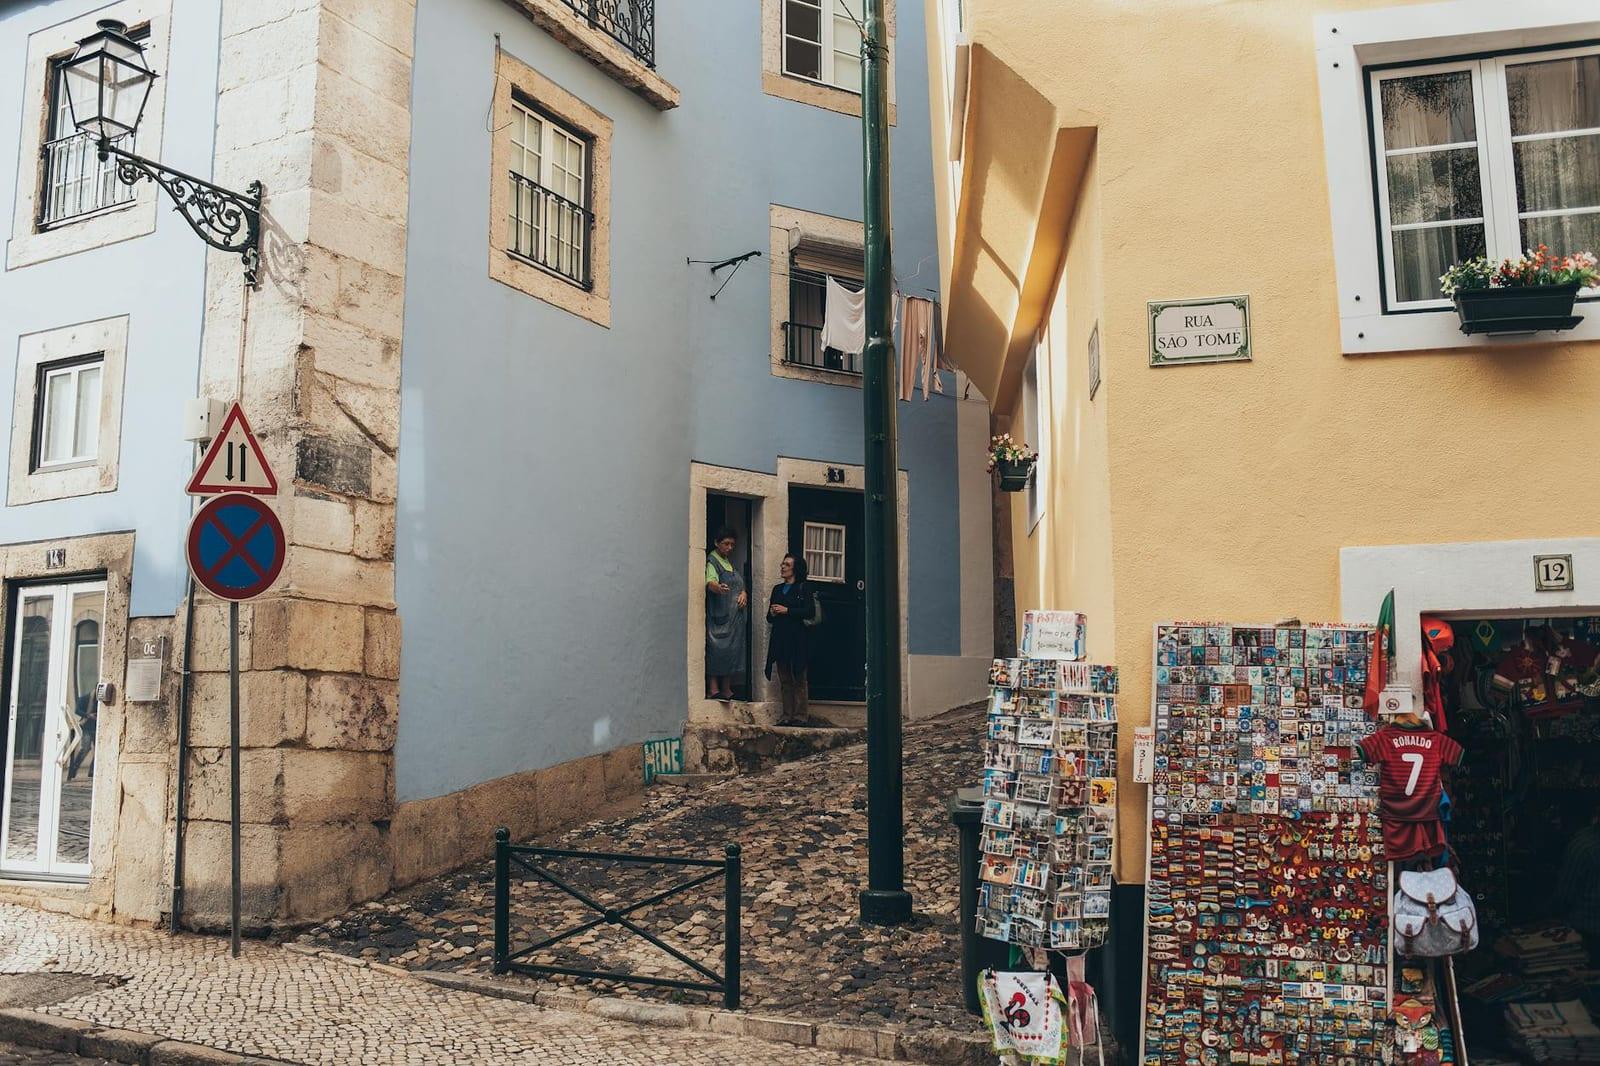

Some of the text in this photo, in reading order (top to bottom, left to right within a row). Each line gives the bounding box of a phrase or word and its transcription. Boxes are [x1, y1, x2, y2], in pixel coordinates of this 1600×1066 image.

[1184, 315, 1213, 328] RUA
[1543, 563, 1565, 581] 12
[1392, 735, 1432, 749] RONALDO
[1401, 753, 1424, 796] 7
[1013, 976, 1039, 1006] PORTUGAL
